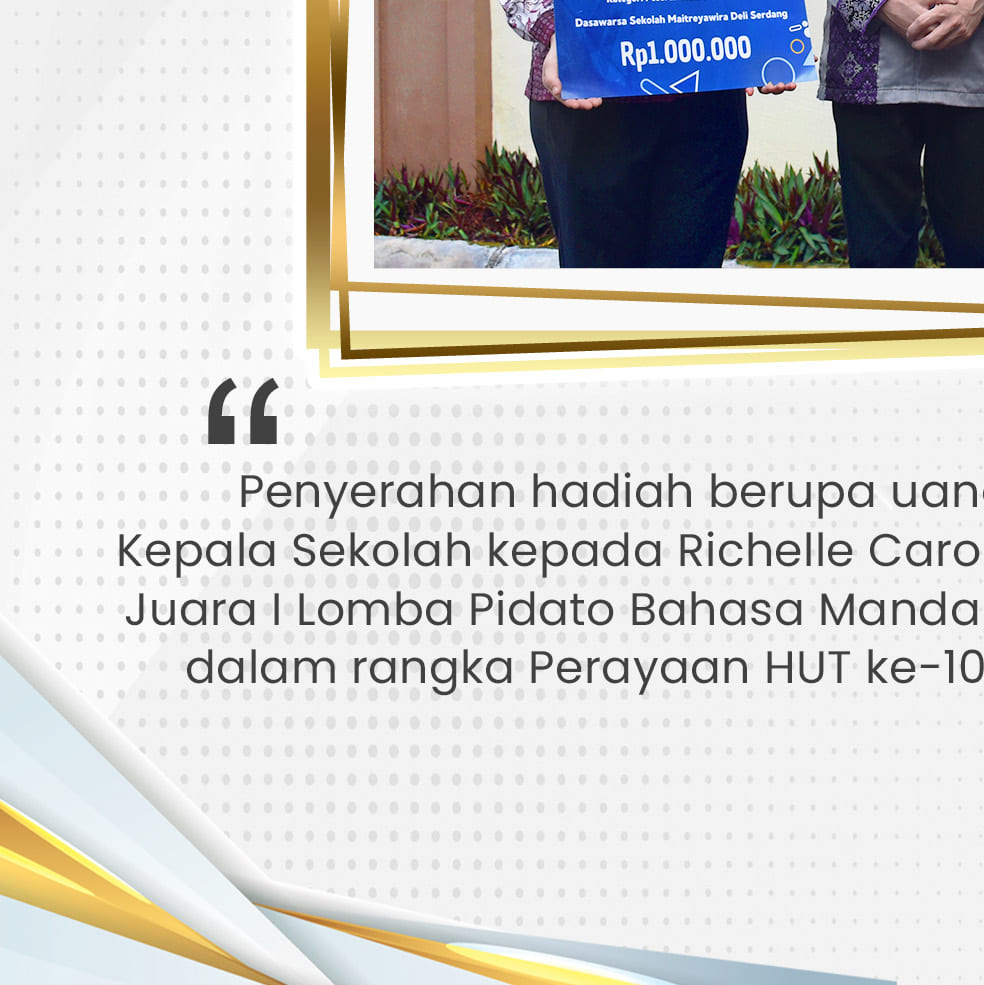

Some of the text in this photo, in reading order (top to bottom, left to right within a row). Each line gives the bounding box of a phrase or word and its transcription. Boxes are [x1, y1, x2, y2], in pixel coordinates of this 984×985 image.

[574, 9, 789, 28] Dasawarsa Sekolah Maitreyawira Deli Serdang
[620, 35, 752, 73] Rp1.000.000
